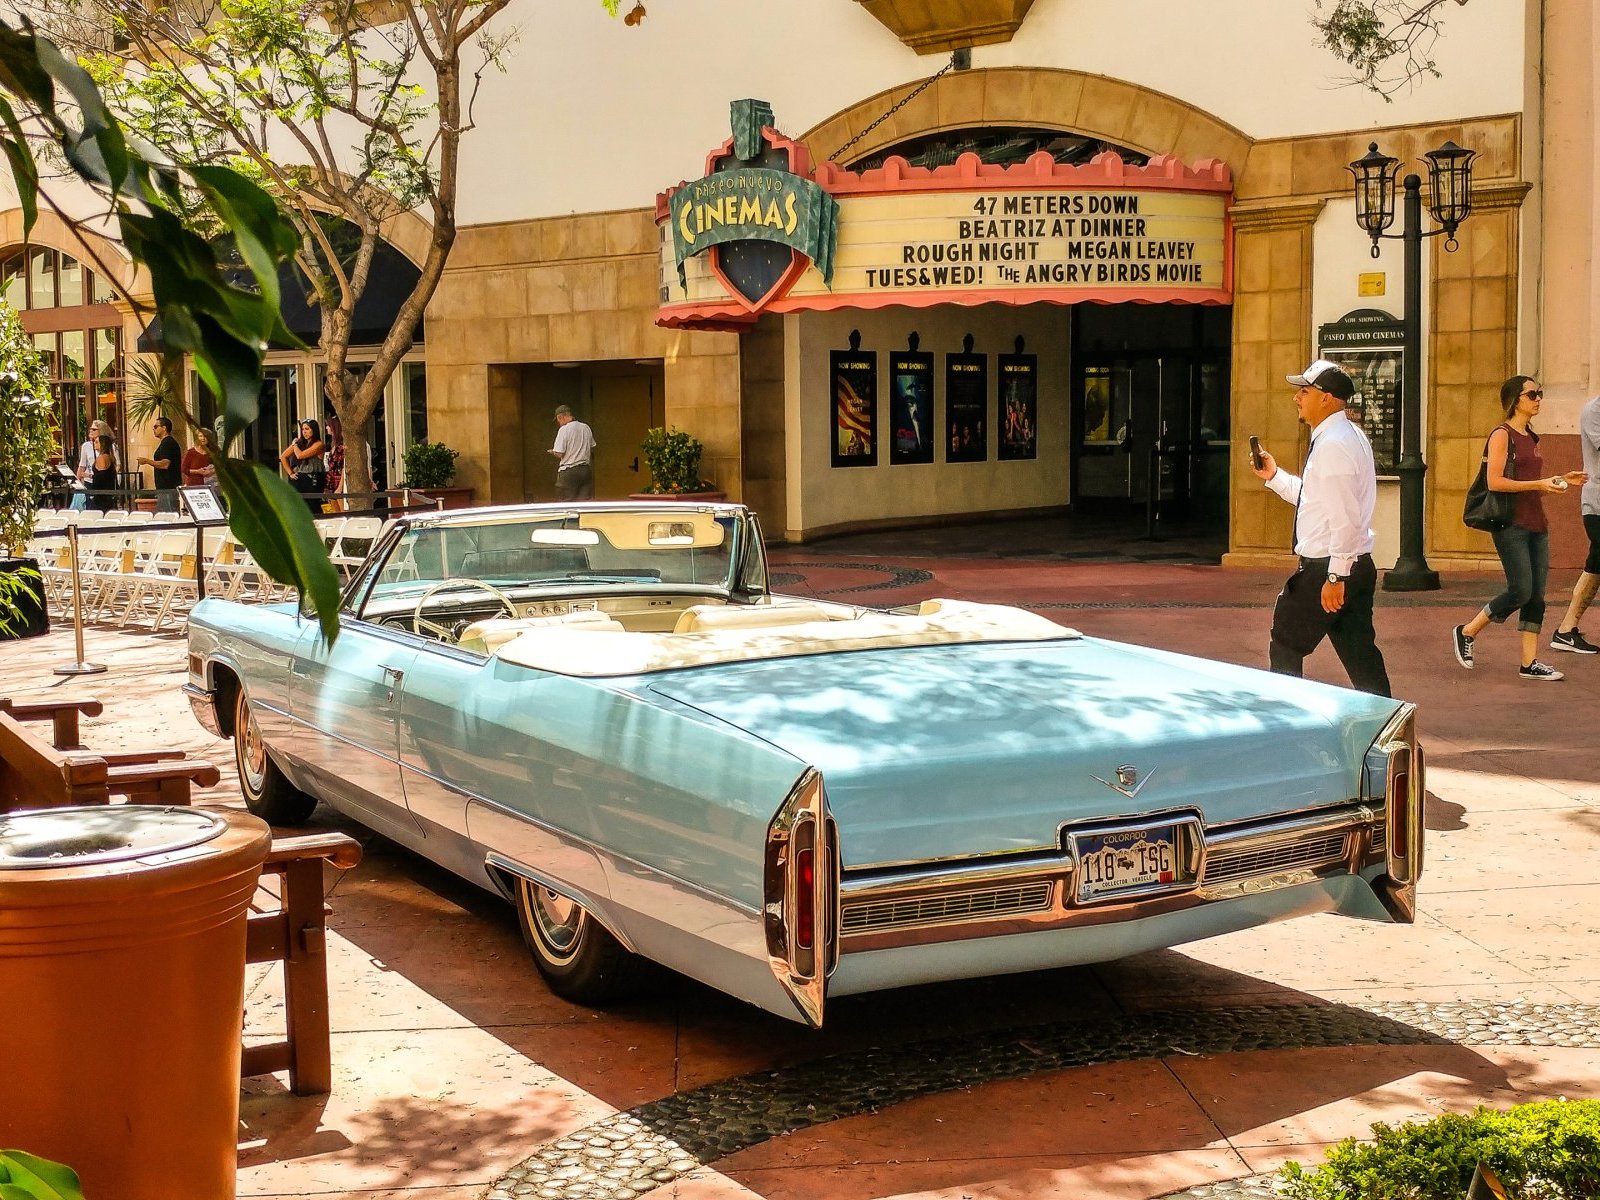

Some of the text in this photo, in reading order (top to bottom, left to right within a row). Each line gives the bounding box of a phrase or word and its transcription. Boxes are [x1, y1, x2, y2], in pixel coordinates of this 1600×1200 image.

[973, 195, 1138, 215] 47 METERS DOWN
[680, 191, 798, 244] CINEMAS
[959, 218, 1146, 239] BEATRIZ AT DINNER
[903, 241, 1195, 263] ROUGH NIGHT MEGAN LEAVEY
[866, 263, 1202, 287] TUES&WED! THE ANGRY BIRDS MOVIE
[1323, 331, 1405, 341] PASEO NUEVO CINEMAS
[1103, 831, 1147, 844] COLORADO
[1083, 844, 1169, 884] 118 ISG
[1102, 879, 1128, 888] COLLECTOR
[1132, 875, 1152, 883] VEHICLE
